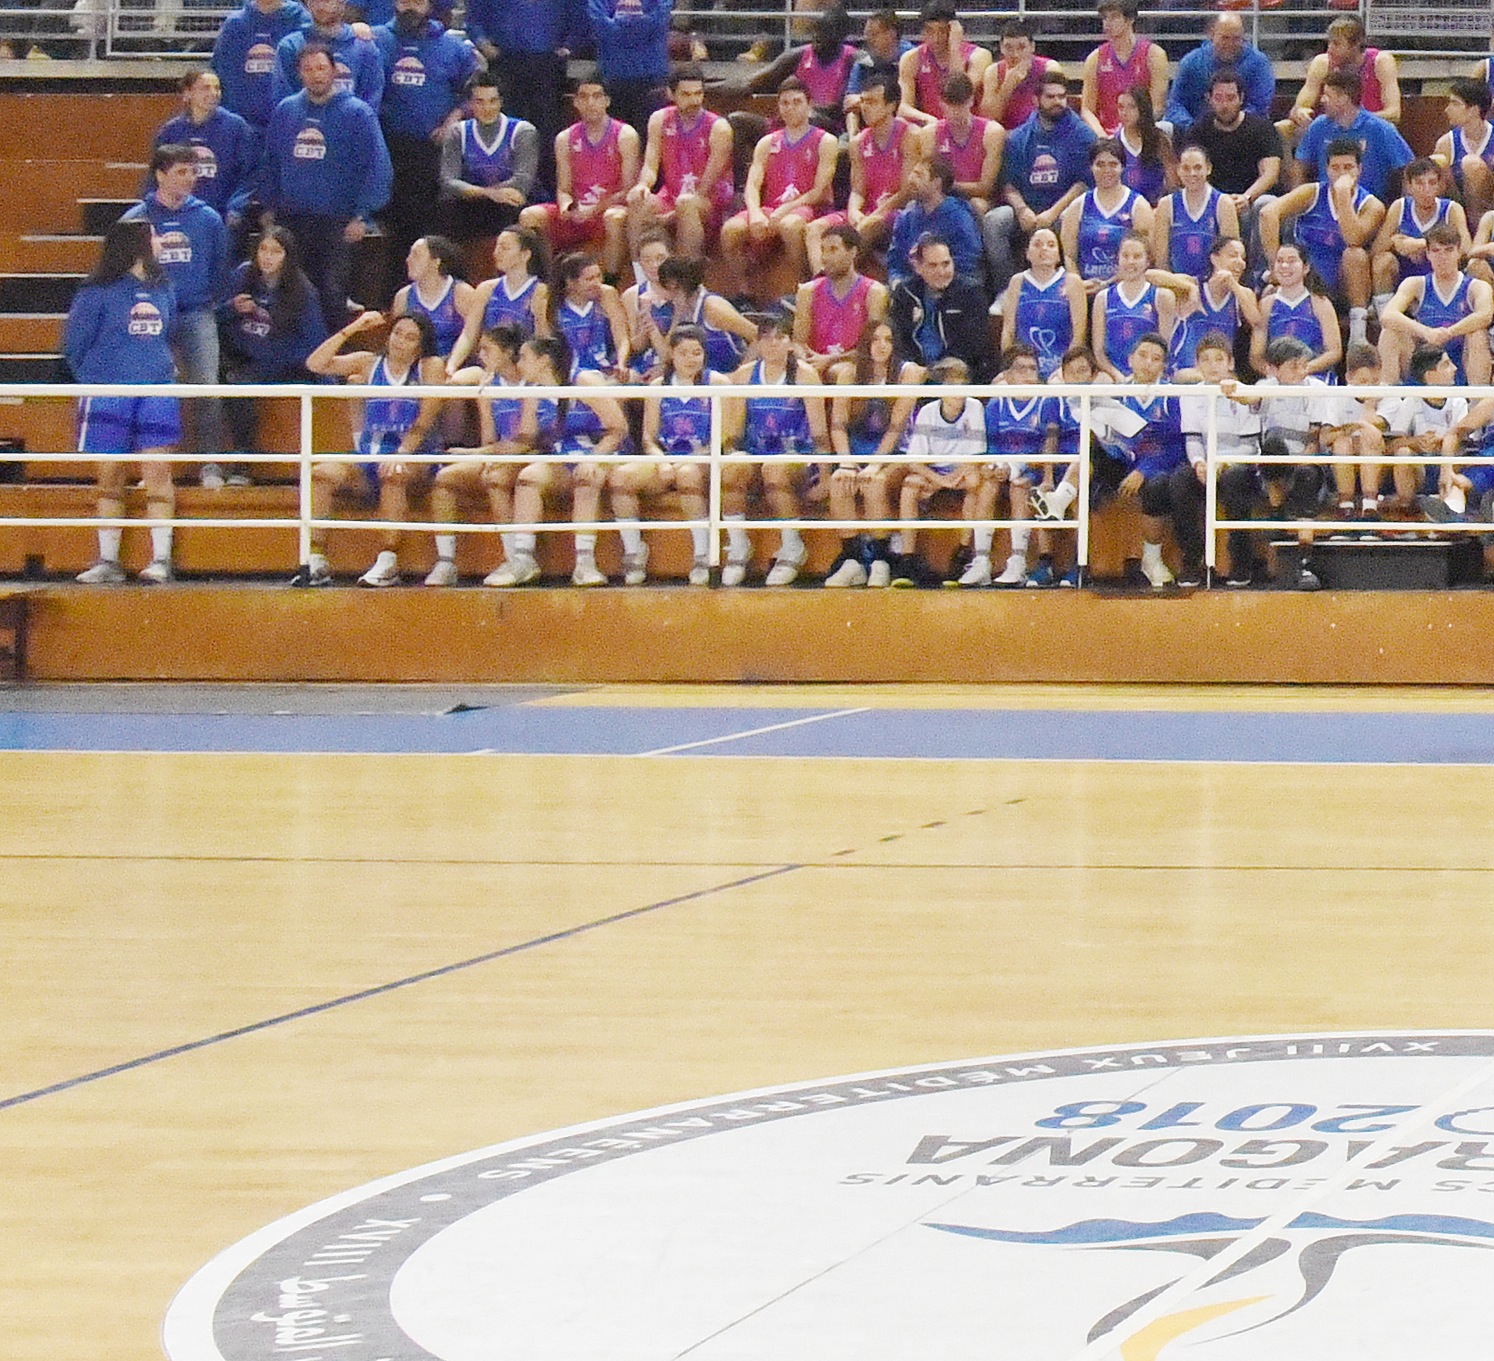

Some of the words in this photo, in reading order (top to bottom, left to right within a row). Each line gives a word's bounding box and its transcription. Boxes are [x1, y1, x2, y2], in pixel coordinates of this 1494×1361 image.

[392, 73, 425, 86] CBT
[294, 144, 326, 158] CBT
[1030, 170, 1058, 184] CBT
[159, 248, 191, 264] CBT
[128, 319, 162, 335] CBT
[1286, 1041, 1439, 1057] XVIII
[1082, 1048, 1251, 1071] JEUX
[1033, 1100, 1423, 1133] 2018
[303, 1218, 422, 1266] XVIII
